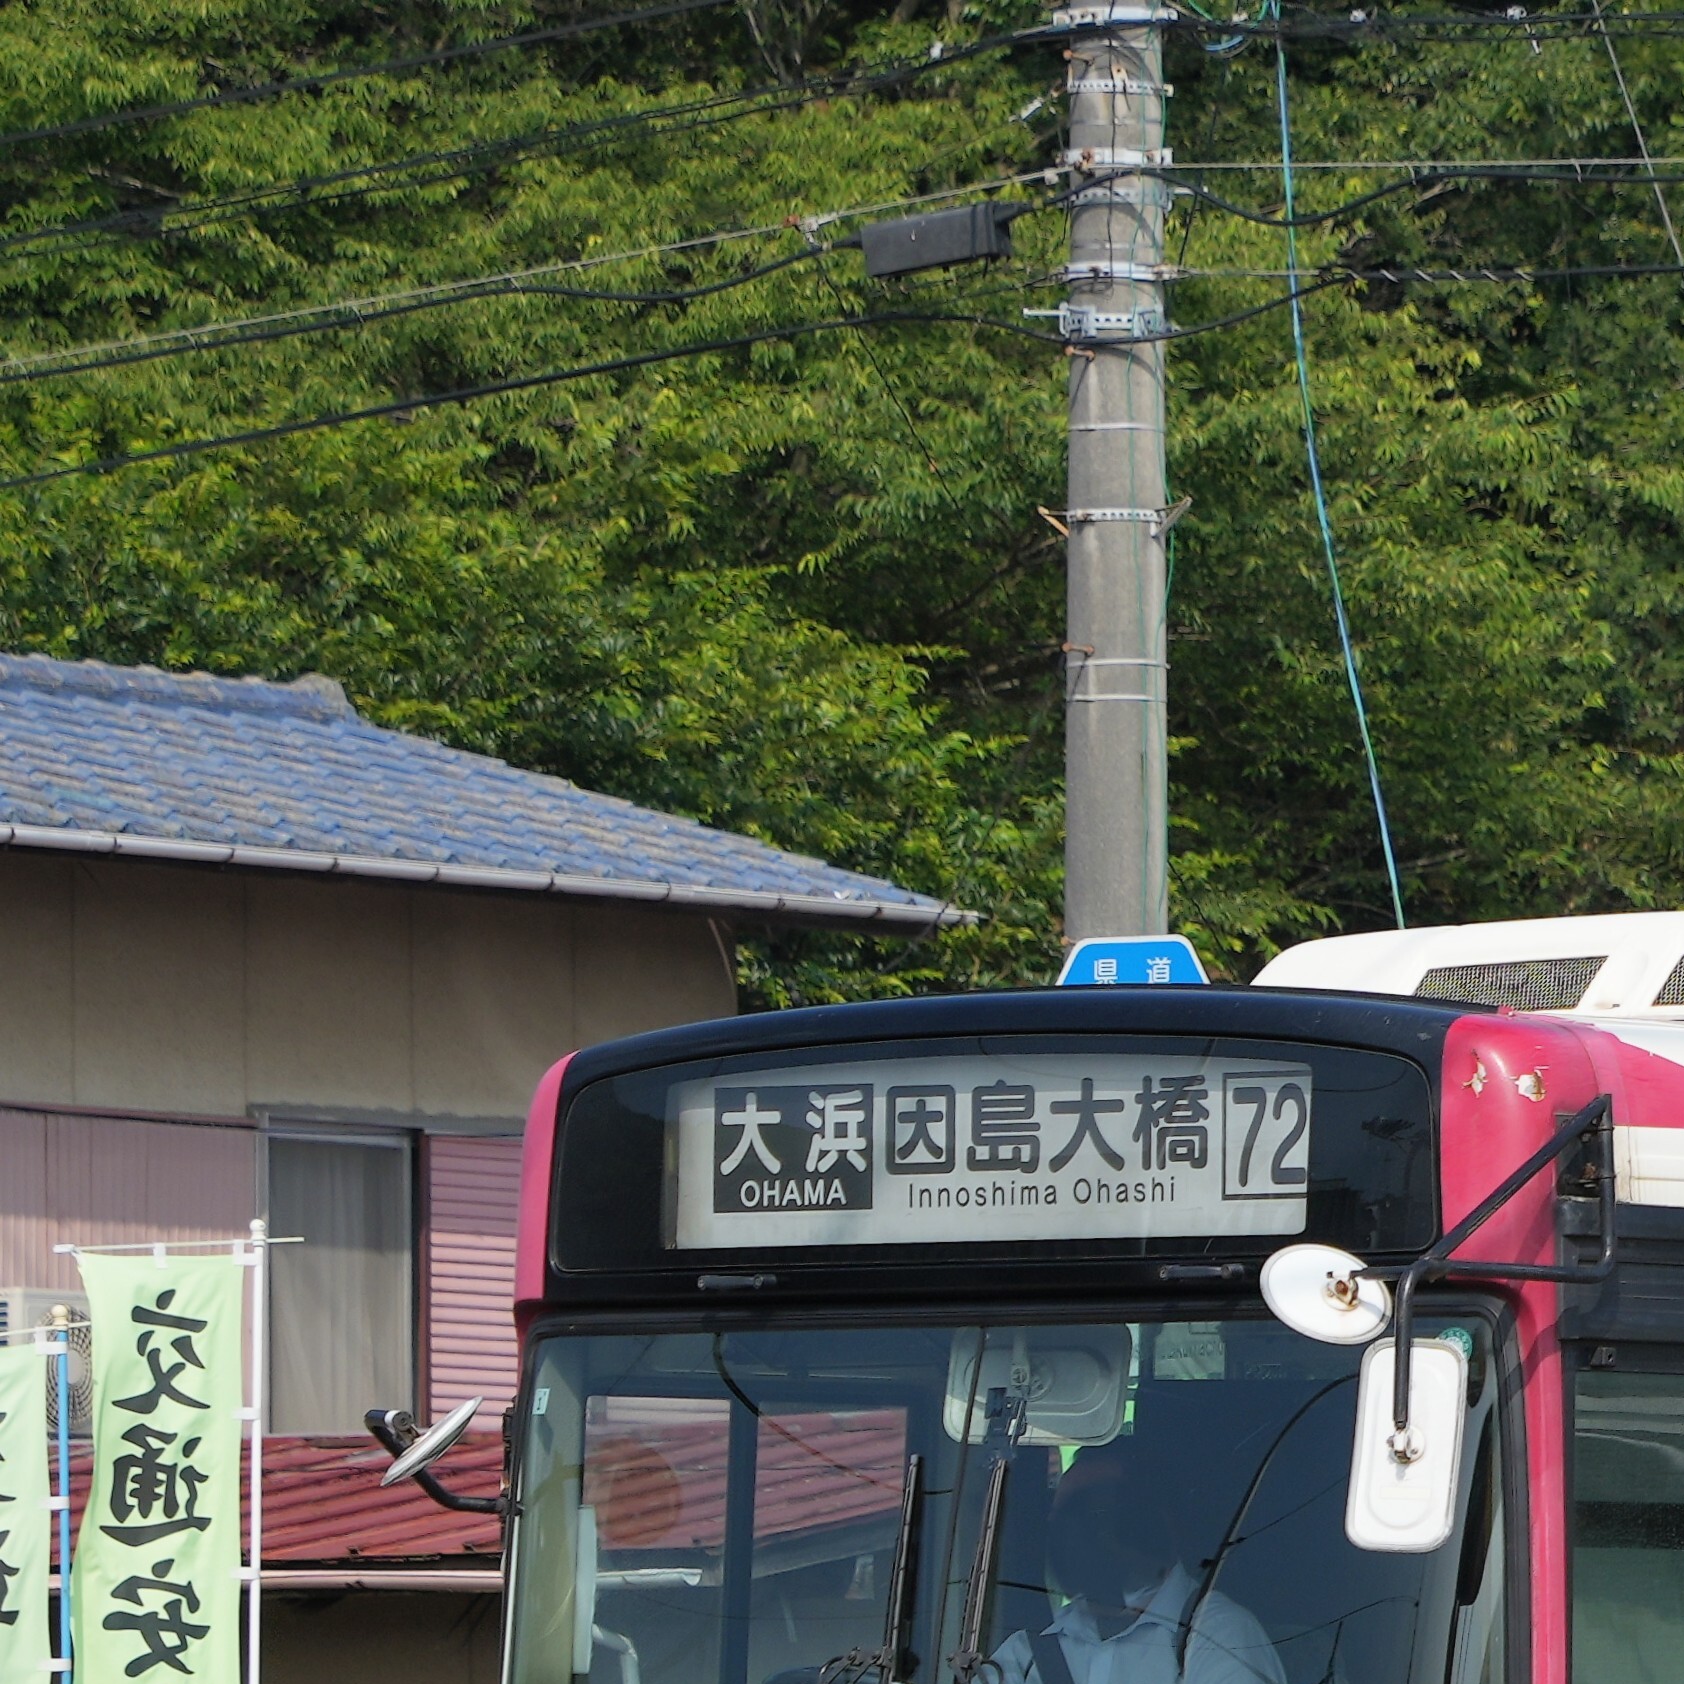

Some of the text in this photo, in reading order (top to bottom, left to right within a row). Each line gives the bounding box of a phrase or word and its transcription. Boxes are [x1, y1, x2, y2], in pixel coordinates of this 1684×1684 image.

[1093, 956, 1172, 984] 県道
[719, 1089, 868, 1176] 大浜
[885, 1074, 1210, 1175] 因島大橋
[1231, 1082, 1308, 1188] 72
[739, 1177, 848, 1208] OHAMA
[908, 1175, 1176, 1209] Innoshima Ohashi
